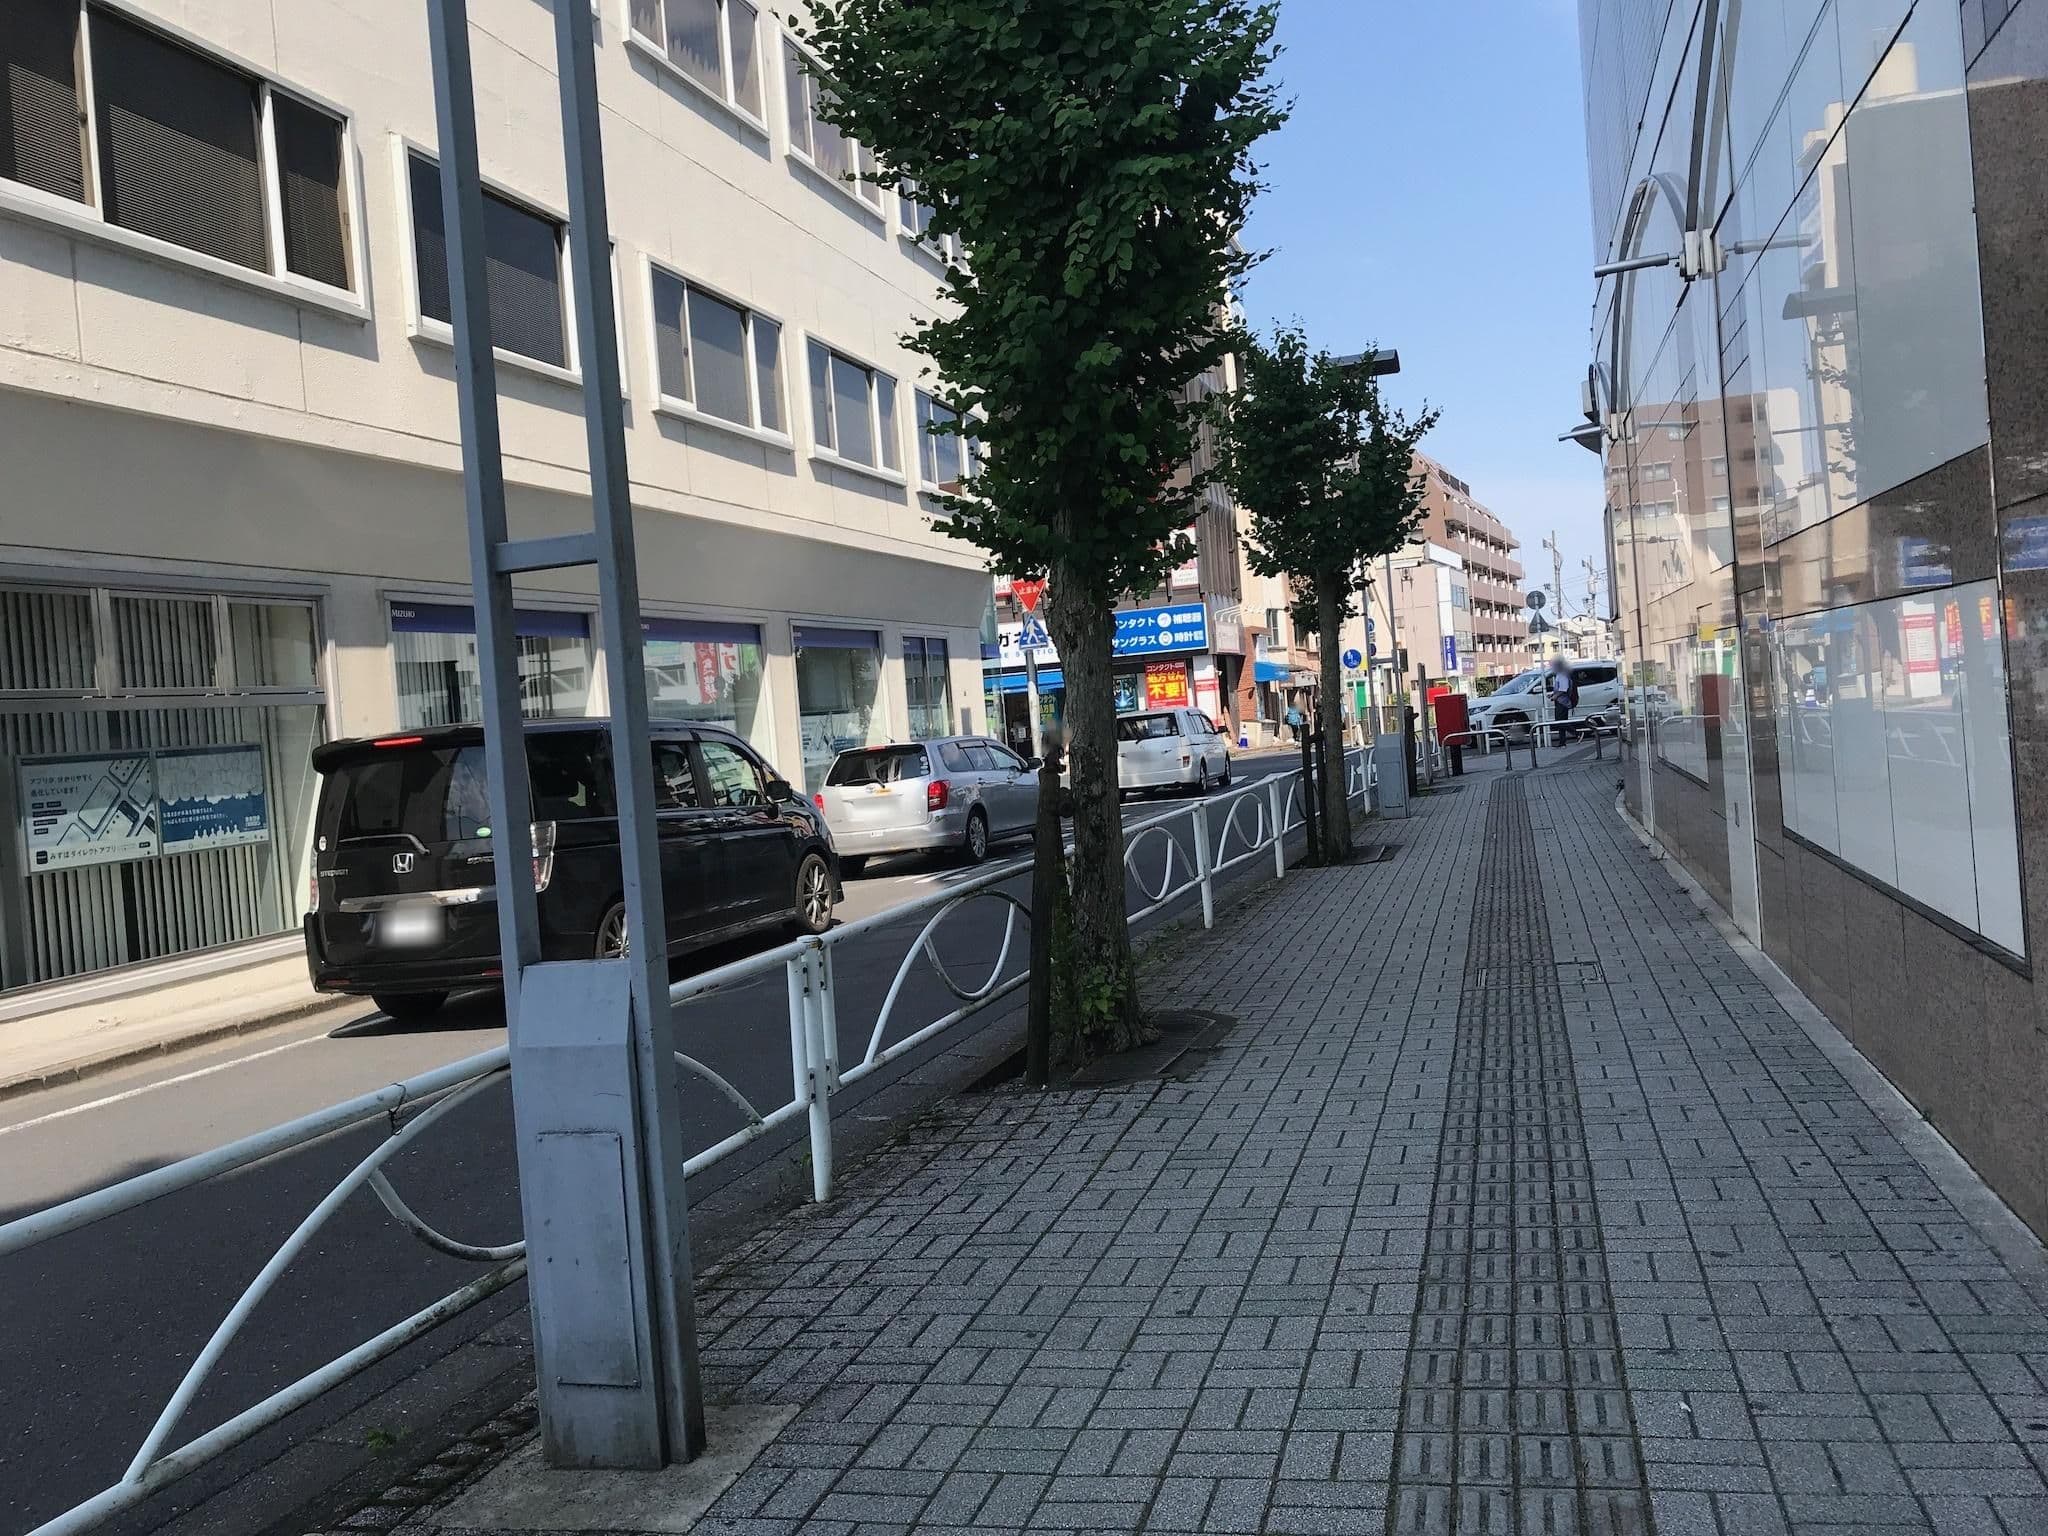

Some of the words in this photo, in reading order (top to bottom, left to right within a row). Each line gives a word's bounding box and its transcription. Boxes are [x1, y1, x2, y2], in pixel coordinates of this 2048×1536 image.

[1019, 584, 1040, 595] 止まれ
[1115, 616, 1156, 630] ンタクト
[1112, 635, 1157, 649] サングラス
[1147, 671, 1185, 683] 処方せん
